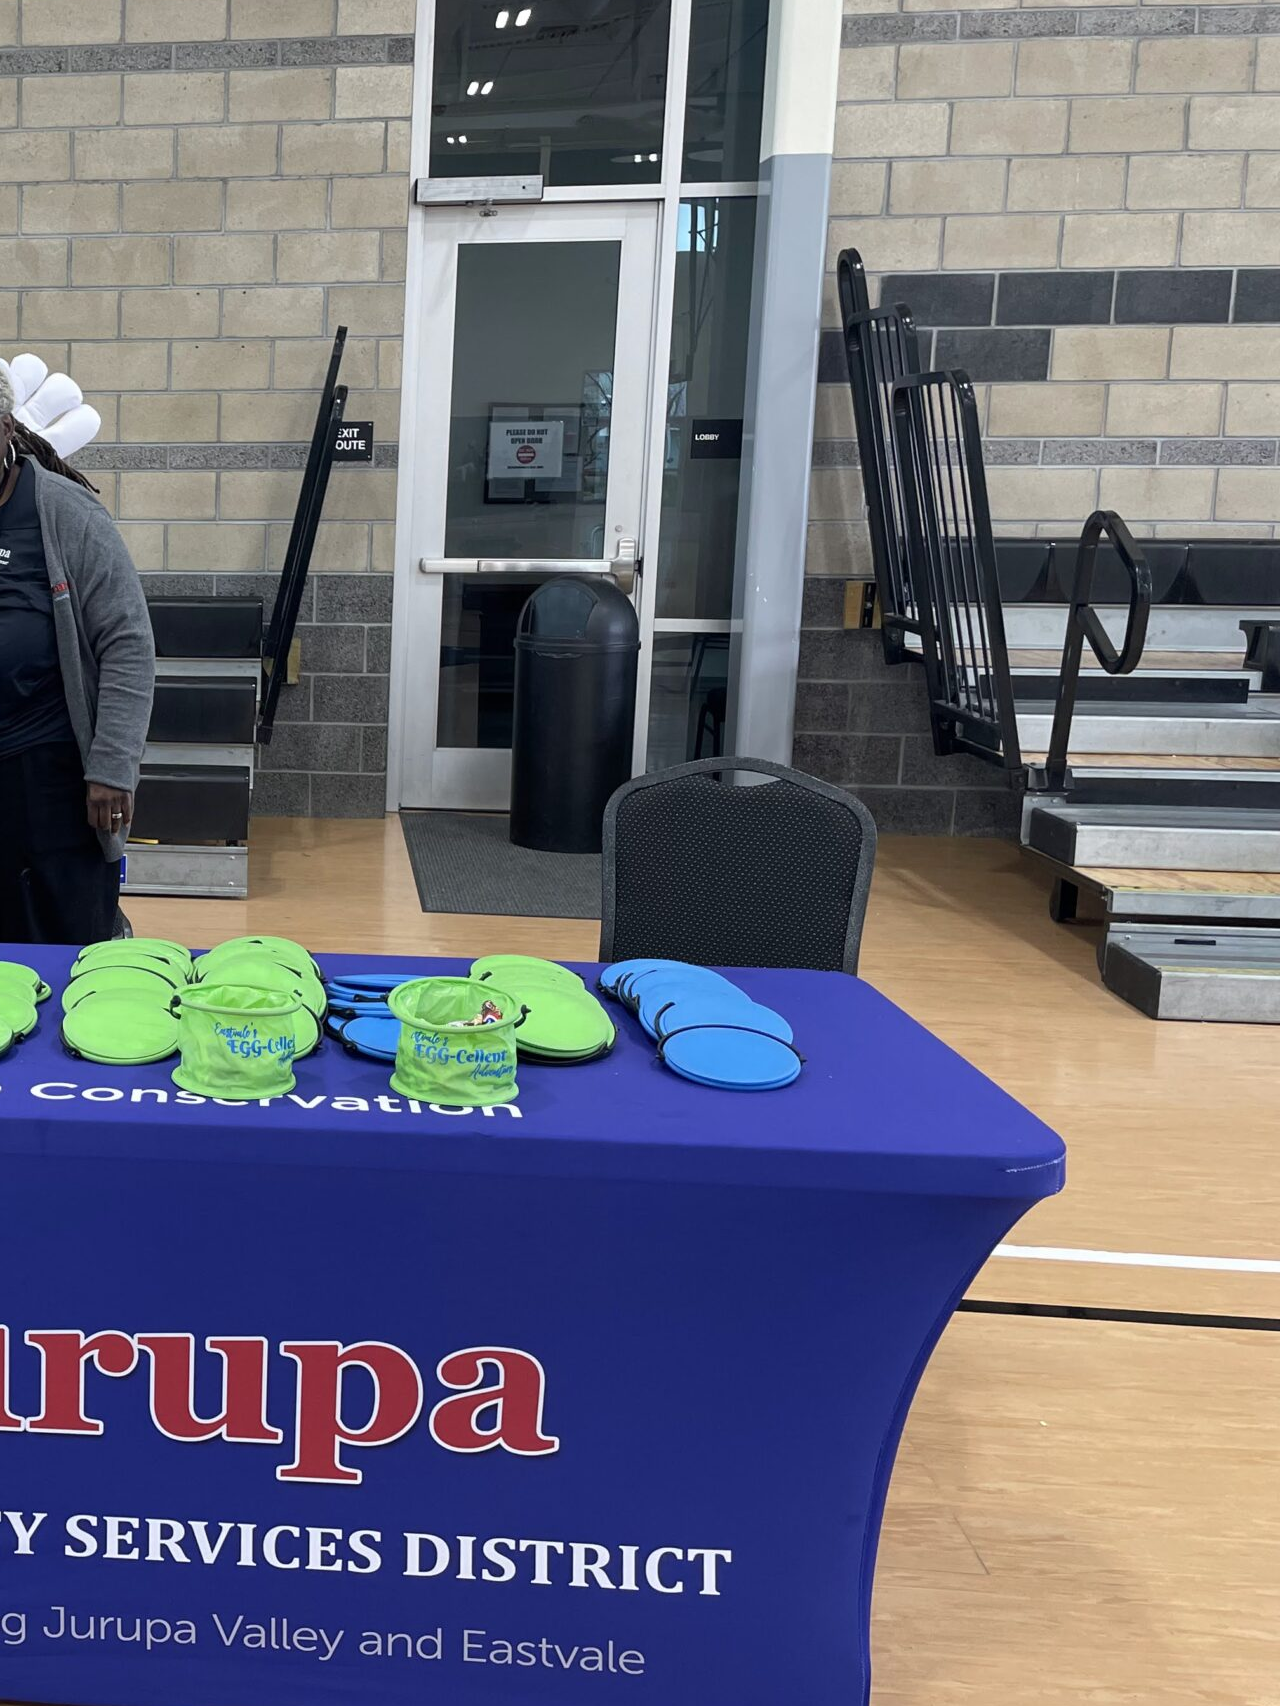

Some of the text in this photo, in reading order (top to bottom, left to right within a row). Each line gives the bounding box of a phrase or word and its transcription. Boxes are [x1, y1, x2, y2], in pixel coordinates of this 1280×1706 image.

[335, 440, 366, 451] OUTE
[695, 433, 720, 441] LOBBY
[414, 1044, 507, 1065] EGG-Cellent
[64, 1514, 383, 1574] SERVICES
[402, 1531, 733, 1597] DISTRICT
[42, 1606, 198, 1651] Jurupa
[212, 1613, 345, 1662] Valley
[358, 1628, 443, 1661] and
[462, 1629, 646, 1676] Eastvale
